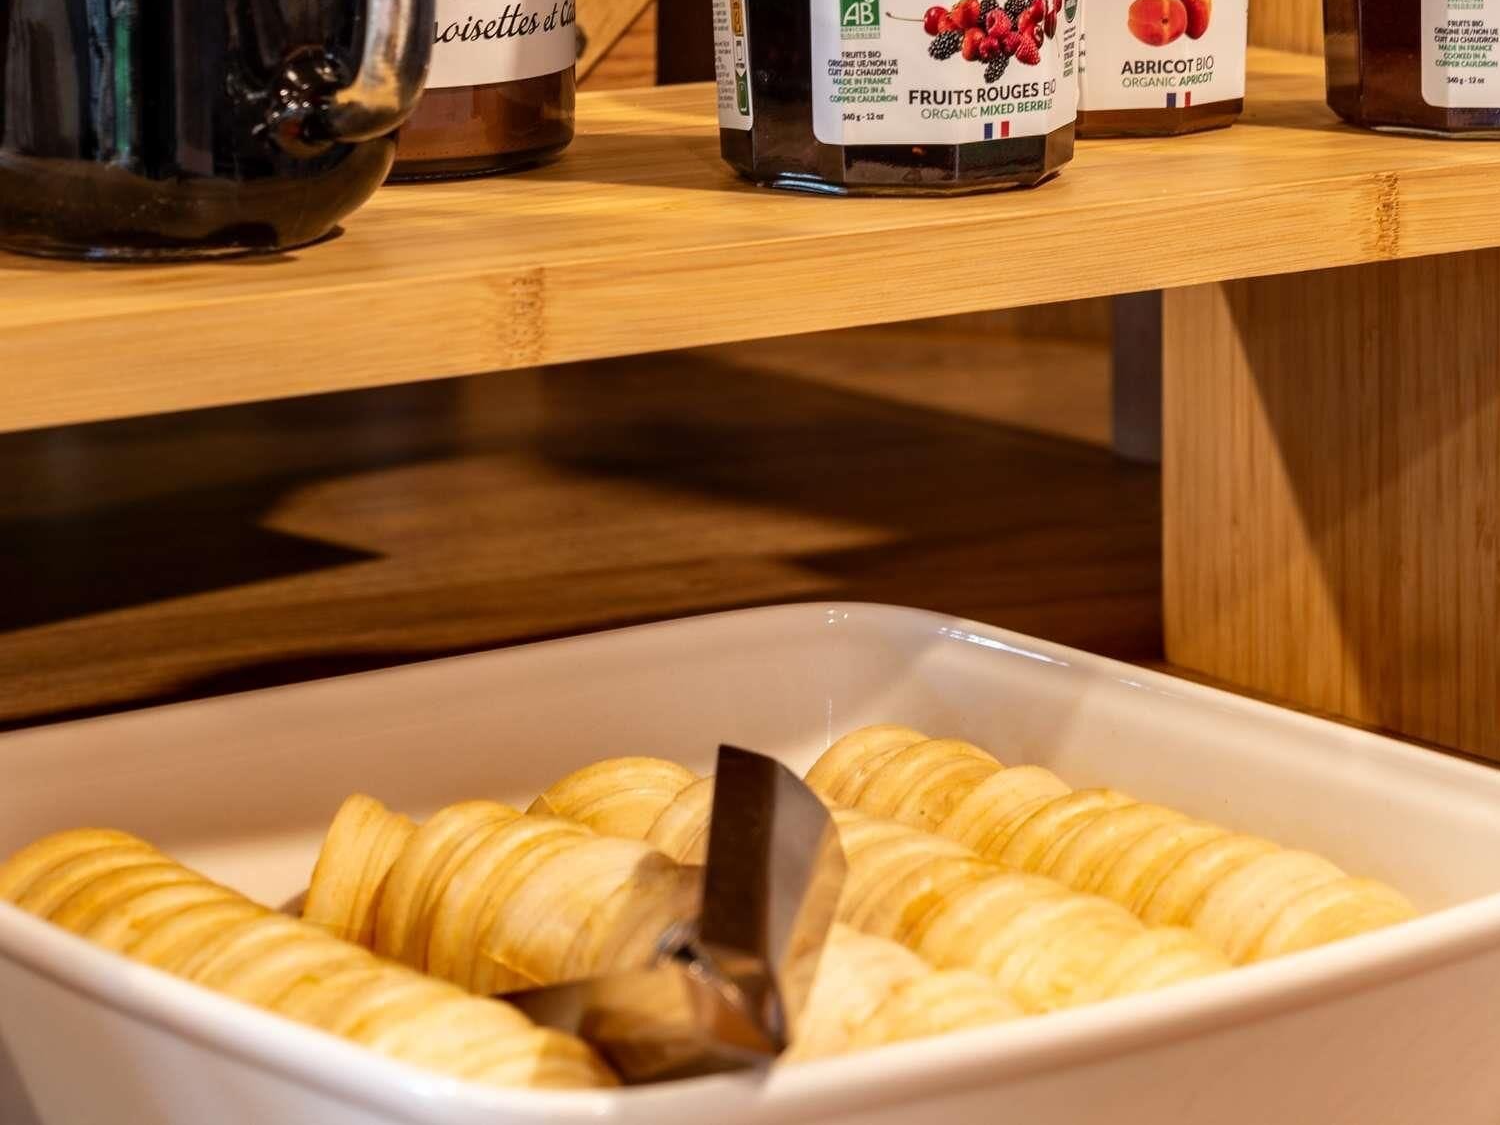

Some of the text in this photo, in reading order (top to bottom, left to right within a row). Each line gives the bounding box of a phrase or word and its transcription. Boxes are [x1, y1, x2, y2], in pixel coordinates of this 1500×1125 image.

[543, 2, 558, 33] et
[843, 2, 875, 25] AB
[843, 68, 854, 76] AU
[1121, 55, 1214, 75] ABRICOT BIO
[832, 77, 892, 85] MADE IN FRANCE
[1121, 72, 1213, 88] ORGANIC APRICOT
[871, 86, 878, 94] IN
[908, 90, 973, 106] FRUITS
[976, 82, 1039, 104] ROUGES
[920, 107, 977, 120] ORGANIC
[980, 103, 1015, 117] MIXED
